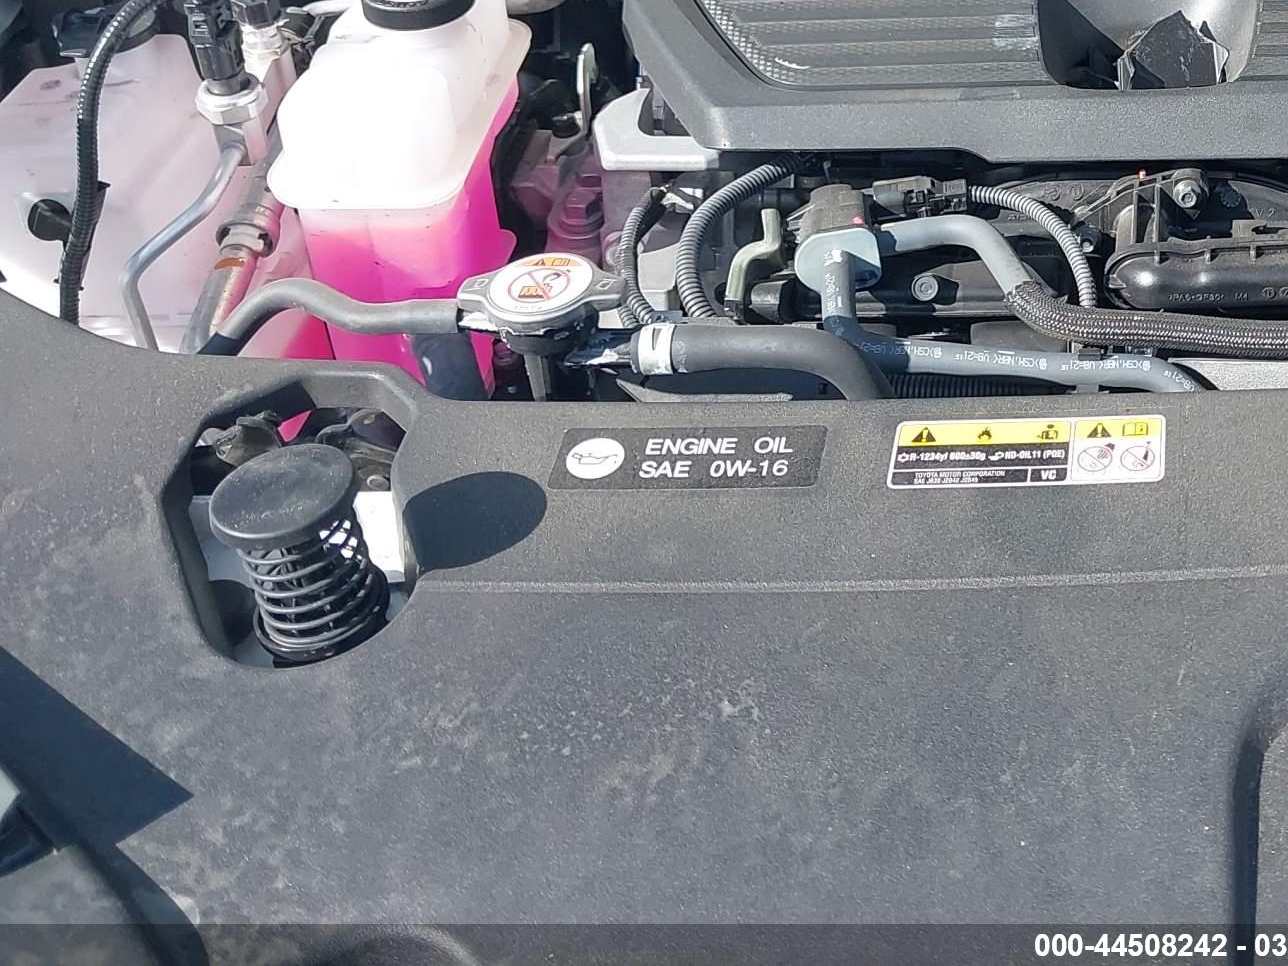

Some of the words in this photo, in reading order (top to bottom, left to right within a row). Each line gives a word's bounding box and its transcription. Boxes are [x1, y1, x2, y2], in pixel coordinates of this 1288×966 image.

[645, 437, 738, 455] ENGINE
[753, 436, 793, 454] OIL
[638, 460, 692, 478] SAE
[709, 460, 789, 477] 0W-16
[962, 469, 1005, 477] CORPORATION
[1040, 470, 1057, 481] VC
